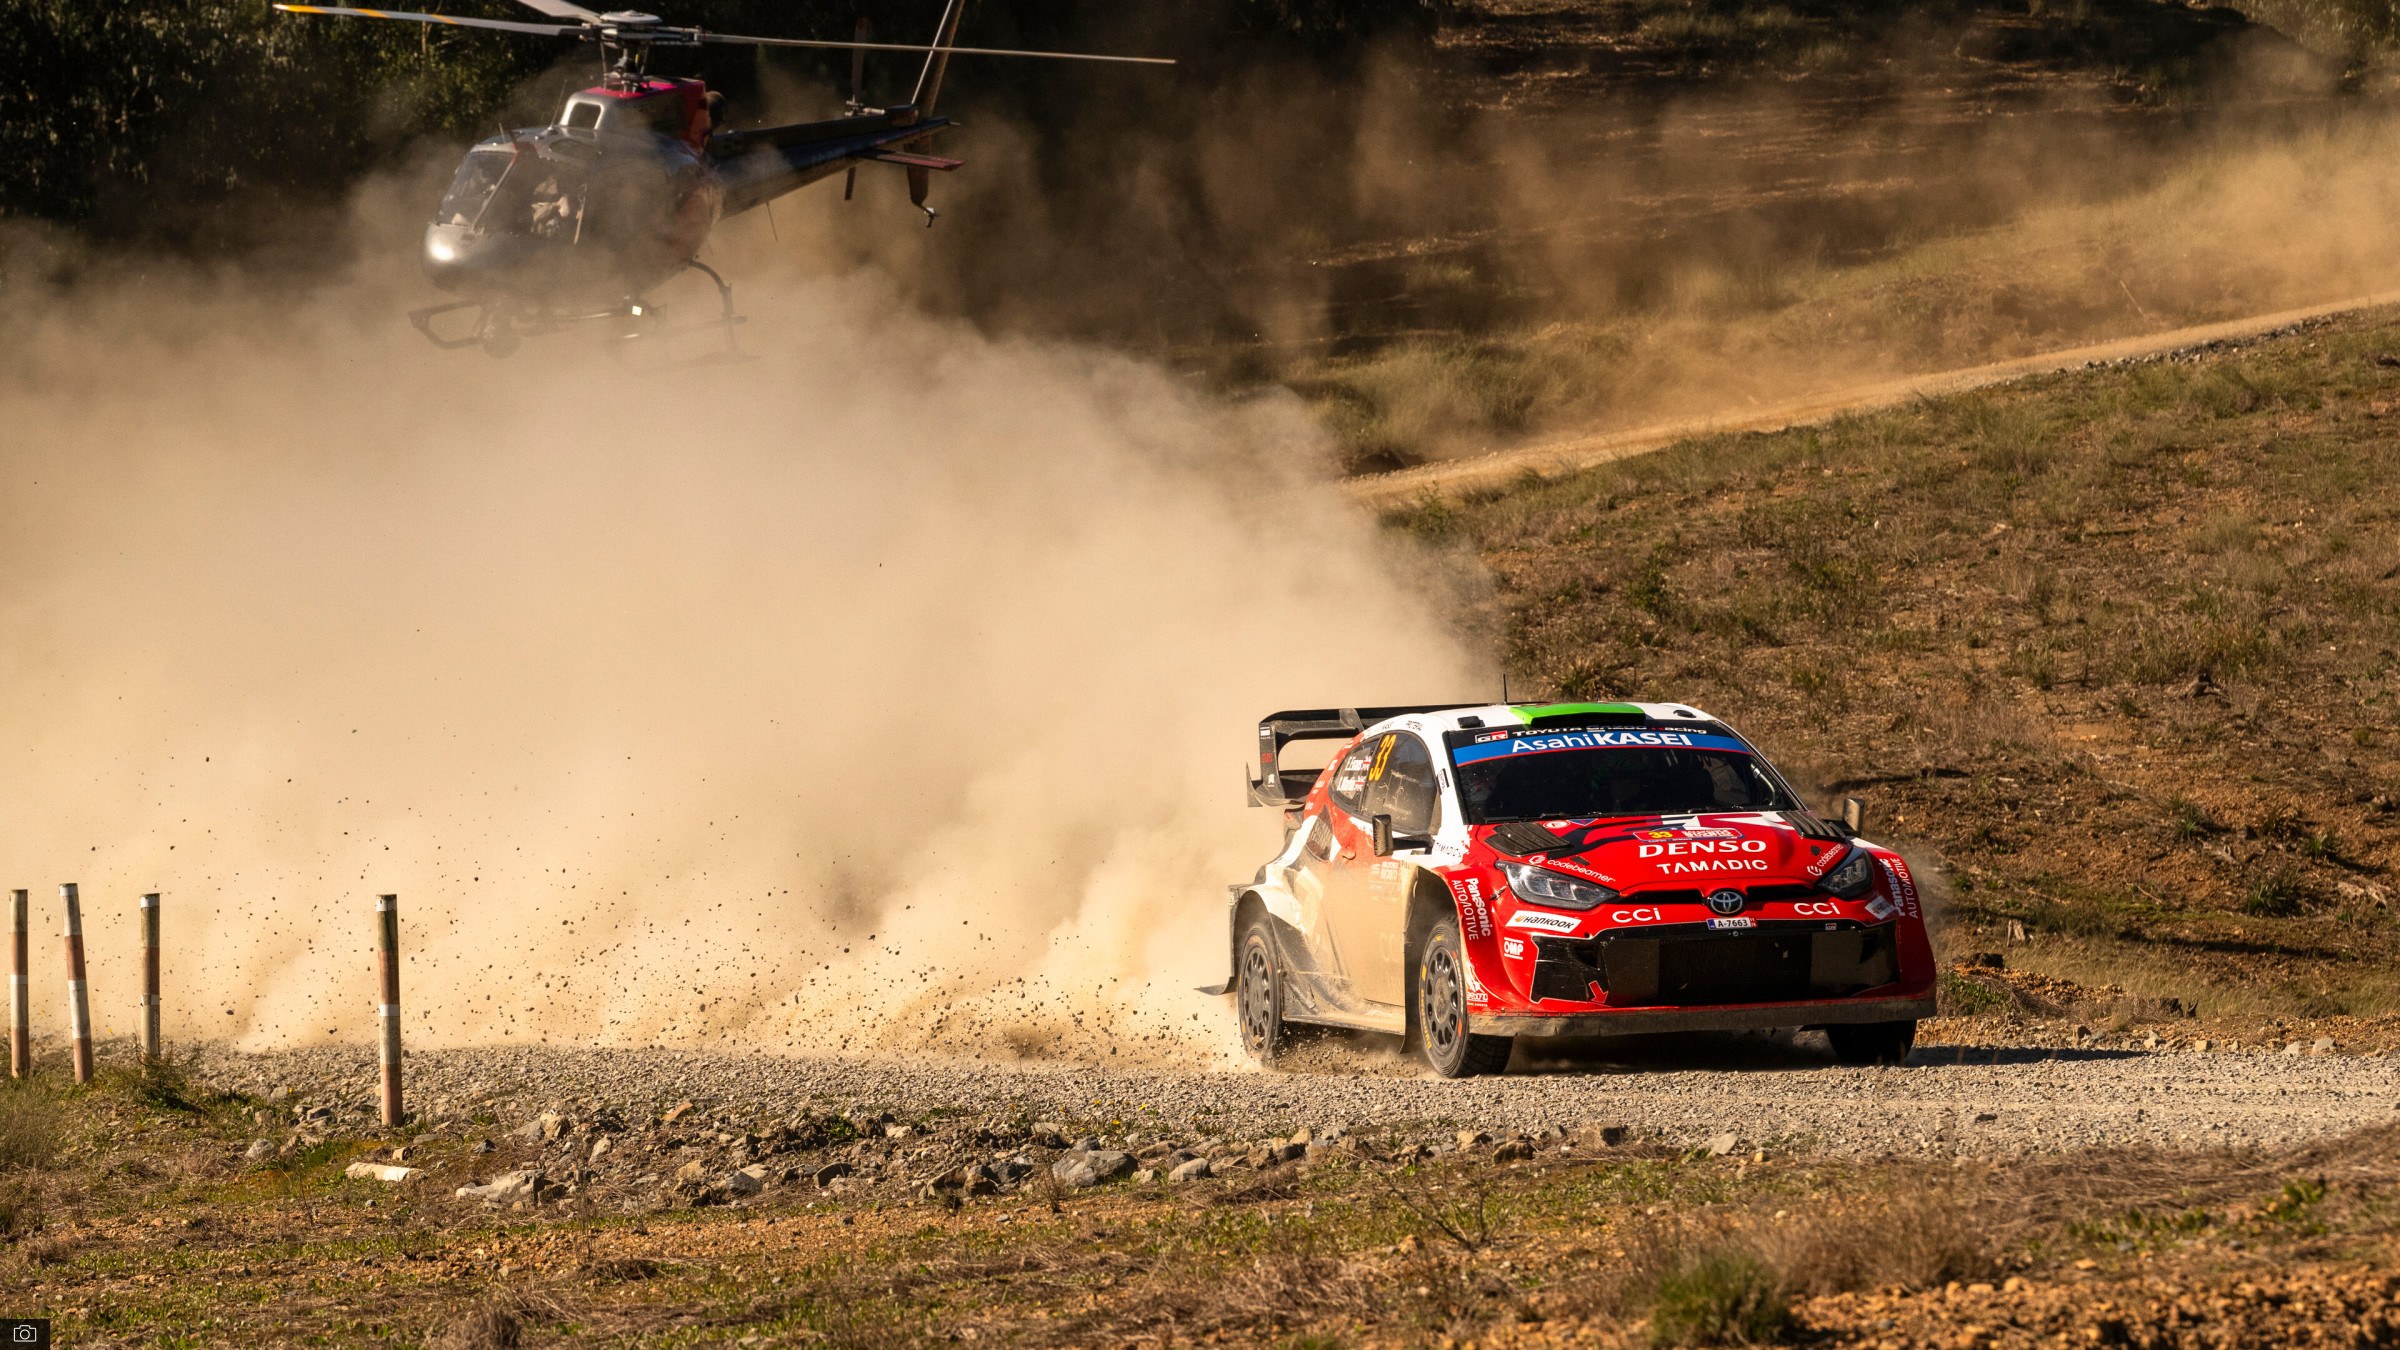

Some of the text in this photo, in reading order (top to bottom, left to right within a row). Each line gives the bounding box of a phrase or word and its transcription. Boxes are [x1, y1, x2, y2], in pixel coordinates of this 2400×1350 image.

[1368, 734, 1397, 781] 33
[1638, 840, 1767, 858] DENSO
[1817, 843, 1846, 867] codebeamer
[1547, 859, 1614, 883] codebeamer
[1656, 859, 1768, 875] TAMADIC
[1465, 877, 1493, 937] Panasonic
[1717, 918, 1748, 928] A-7663
[1503, 940, 1524, 956] OMP
